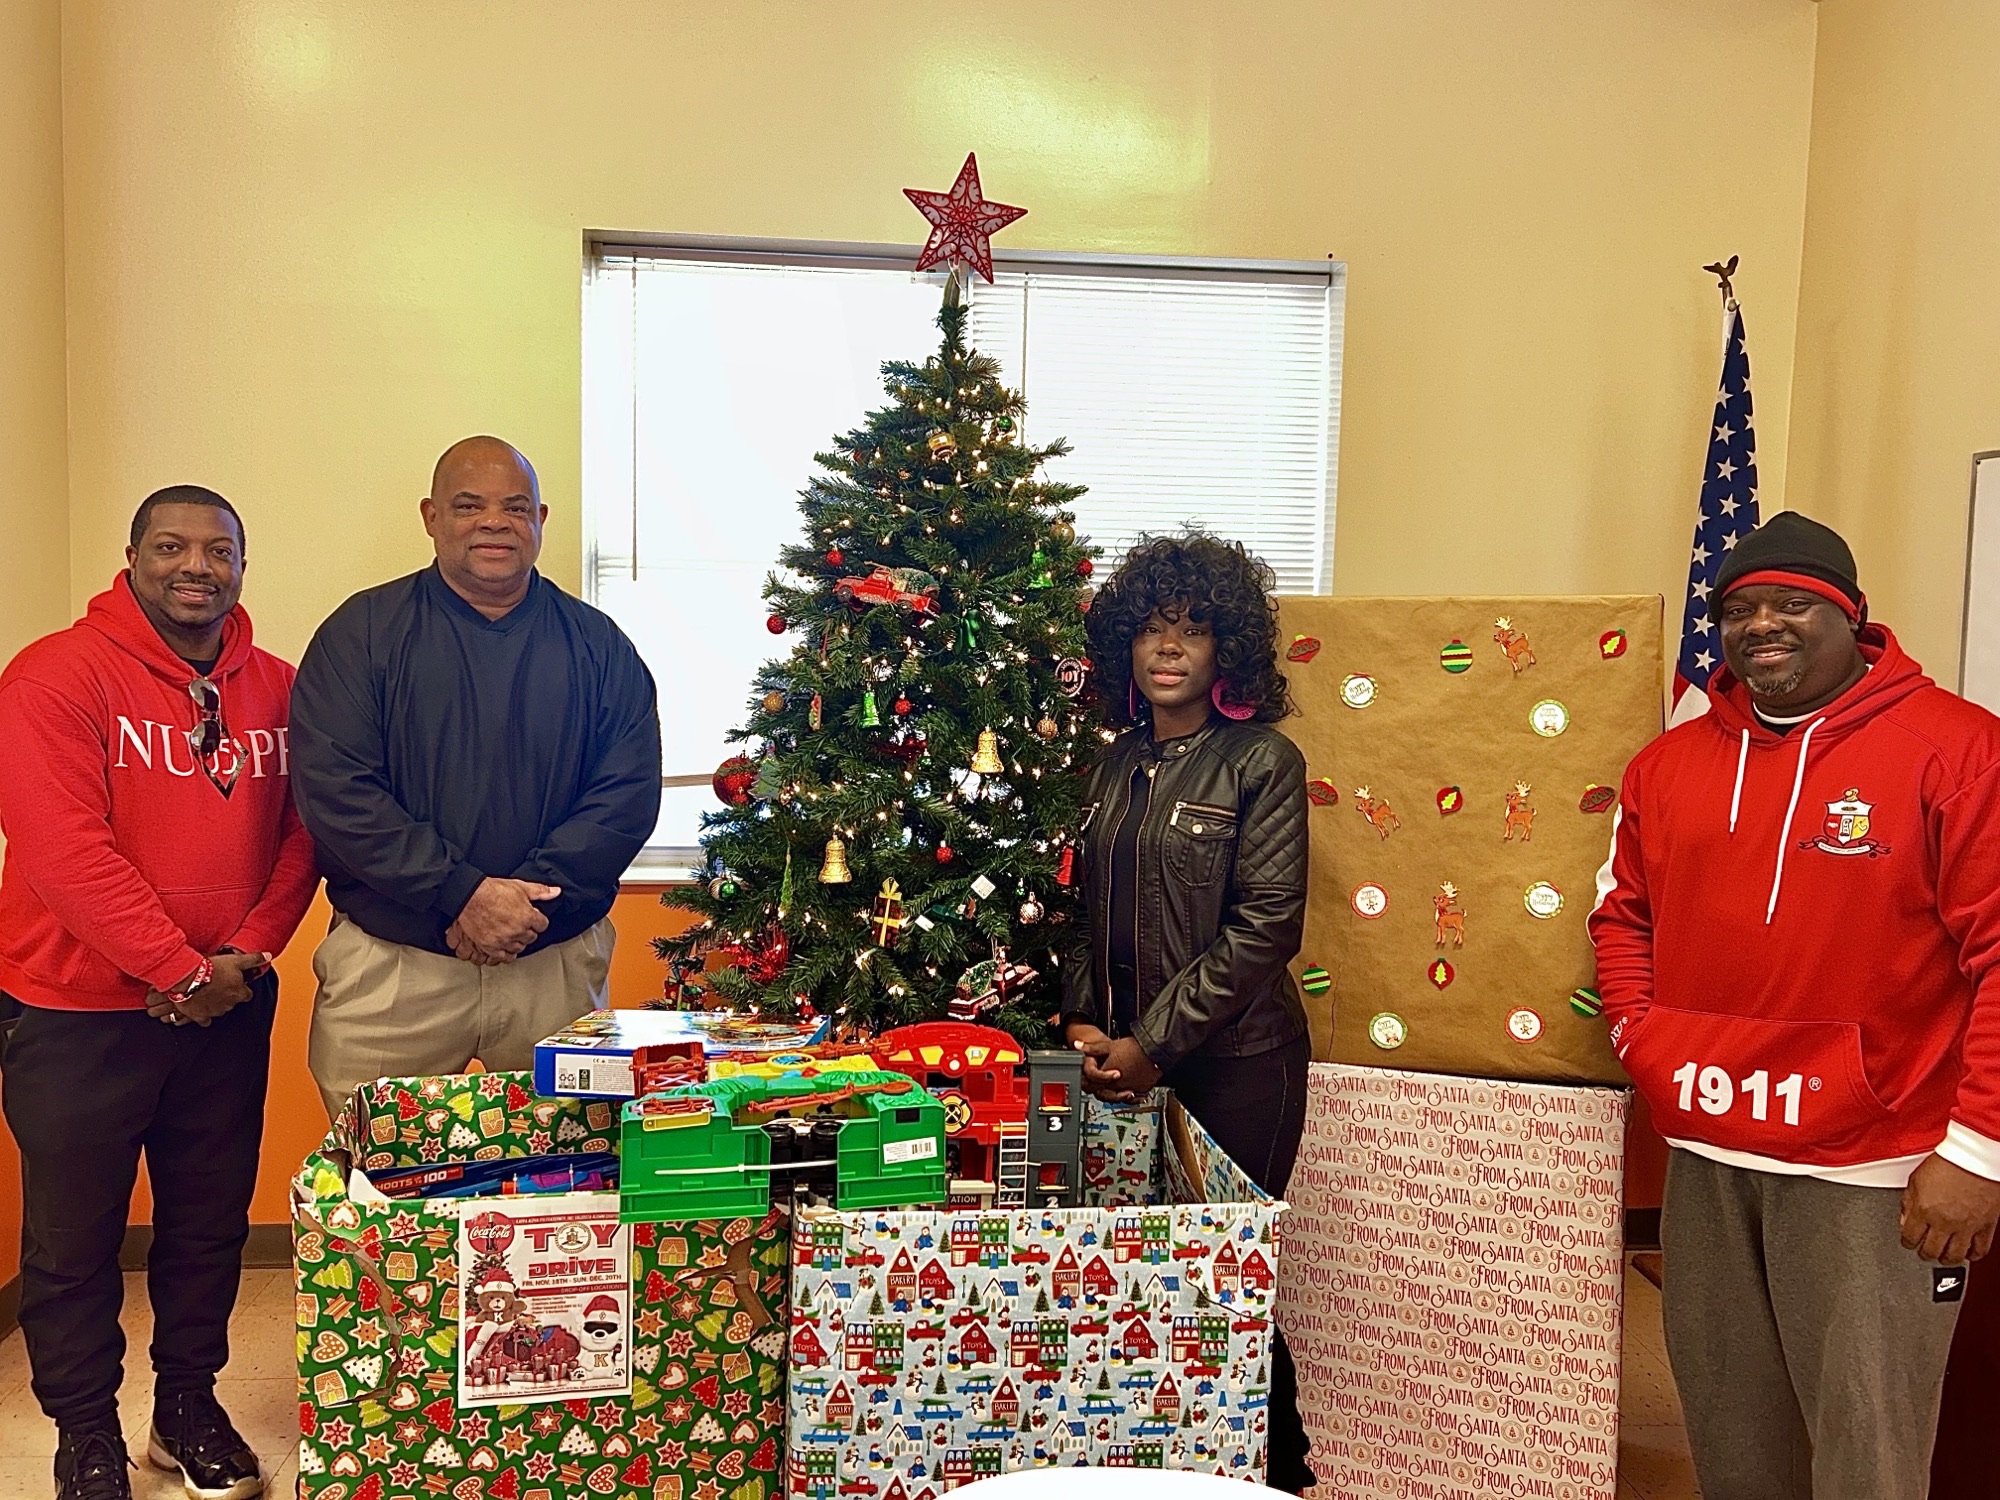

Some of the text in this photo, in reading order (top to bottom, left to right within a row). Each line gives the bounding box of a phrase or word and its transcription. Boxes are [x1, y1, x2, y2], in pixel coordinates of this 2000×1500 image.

[114, 715, 195, 777] NU
[1326, 1073, 1366, 1095] SANTA
[1389, 1079, 1469, 1106] FROM SANTA
[1315, 1096, 1392, 1122] FROM SANTA
[1493, 1089, 1576, 1116] FROM SANTA
[1049, 1117, 1062, 1131] 3
[1415, 1107, 1496, 1134] FROM SANTA
[1520, 1117, 1604, 1146] FROM SANTA
[1340, 1123, 1376, 1148] FROM
[1377, 1127, 1419, 1150] SANTA
[1441, 1135, 1523, 1162] FROM SANTA
[1304, 1143, 1343, 1164] SANTA
[1365, 1151, 1445, 1179] FROM SANTA
[1547, 1146, 1623, 1175] FROM SANT
[373, 1177, 413, 1190] HOOTS
[424, 1170, 447, 1184] 100
[1293, 1167, 1368, 1192] FROM SANTA
[1467, 1163, 1550, 1191] FROM SANTA
[1574, 1175, 1614, 1202] FROM
[949, 1195, 977, 1204] ATION
[1046, 1197, 1059, 1208] 2
[1391, 1179, 1471, 1207] FROM SANTA
[1494, 1192, 1577, 1219] FROM SANTA
[1318, 1195, 1353, 1218] FROM
[1354, 1199, 1394, 1221] SANTA
[1282, 1213, 1321, 1234] SANTA
[1417, 1208, 1497, 1236] FROM SANTA
[1521, 1220, 1604, 1249] FROM SANTA
[1343, 1223, 1420, 1250] FROM SANTA
[1443, 1236, 1524, 1264] FROM SANTA
[1307, 1242, 1345, 1263] SANTA
[1368, 1251, 1445, 1279] FROM SANTA
[1548, 1250, 1588, 1276] FROM
[1295, 1264, 1370, 1291] FROM SANTA
[1469, 1265, 1551, 1294] FROM SANTA
[1276, 1285, 1299, 1304] ANTA
[1393, 1280, 1472, 1308] FROM SANTA
[1575, 1279, 1615, 1306] FROM
[1320, 1293, 1396, 1320] FROM SANTA
[1495, 1294, 1535, 1320] FROM
[1535, 1300, 1578, 1323] SANTA
[1284, 1311, 1323, 1332] SANTA
[1418, 1308, 1499, 1337] FROM SANTA
[1288, 1335, 1347, 1361] ROM SANTA
[1345, 1322, 1421, 1349] FROM SANTA
[1522, 1324, 1605, 1352] FROM SANTA
[594, 1354, 608, 1367] K
[1369, 1350, 1447, 1378] FROM SANTA
[1444, 1337, 1525, 1366] FROM SANTA
[1298, 1362, 1372, 1389] FROM SANTA
[1471, 1366, 1552, 1395] FROM SANTA
[1549, 1353, 1619, 1382] FROM SAN
[1322, 1390, 1398, 1418] FROM SANTA
[1395, 1379, 1474, 1408] FROM SANTA
[1576, 1382, 1617, 1410] FROM
[1302, 1410, 1325, 1429] ANTA
[1420, 1408, 1500, 1438] FROM SANTA
[1497, 1395, 1536, 1422] FROM
[1537, 1402, 1579, 1425] SANTA
[1310, 1436, 1349, 1457] SANTA
[1347, 1419, 1423, 1447] FROM SANTA
[1524, 1426, 1607, 1456] FROM SANTA
[1371, 1448, 1449, 1477] FROM SANTA
[1446, 1438, 1527, 1467] FROM SANTA
[1335, 1466, 1374, 1487] SANTA
[1472, 1467, 1554, 1498] FROM SANTA
[1551, 1456, 1590, 1482] FROM
[1397, 1478, 1433, 1500] FROM
